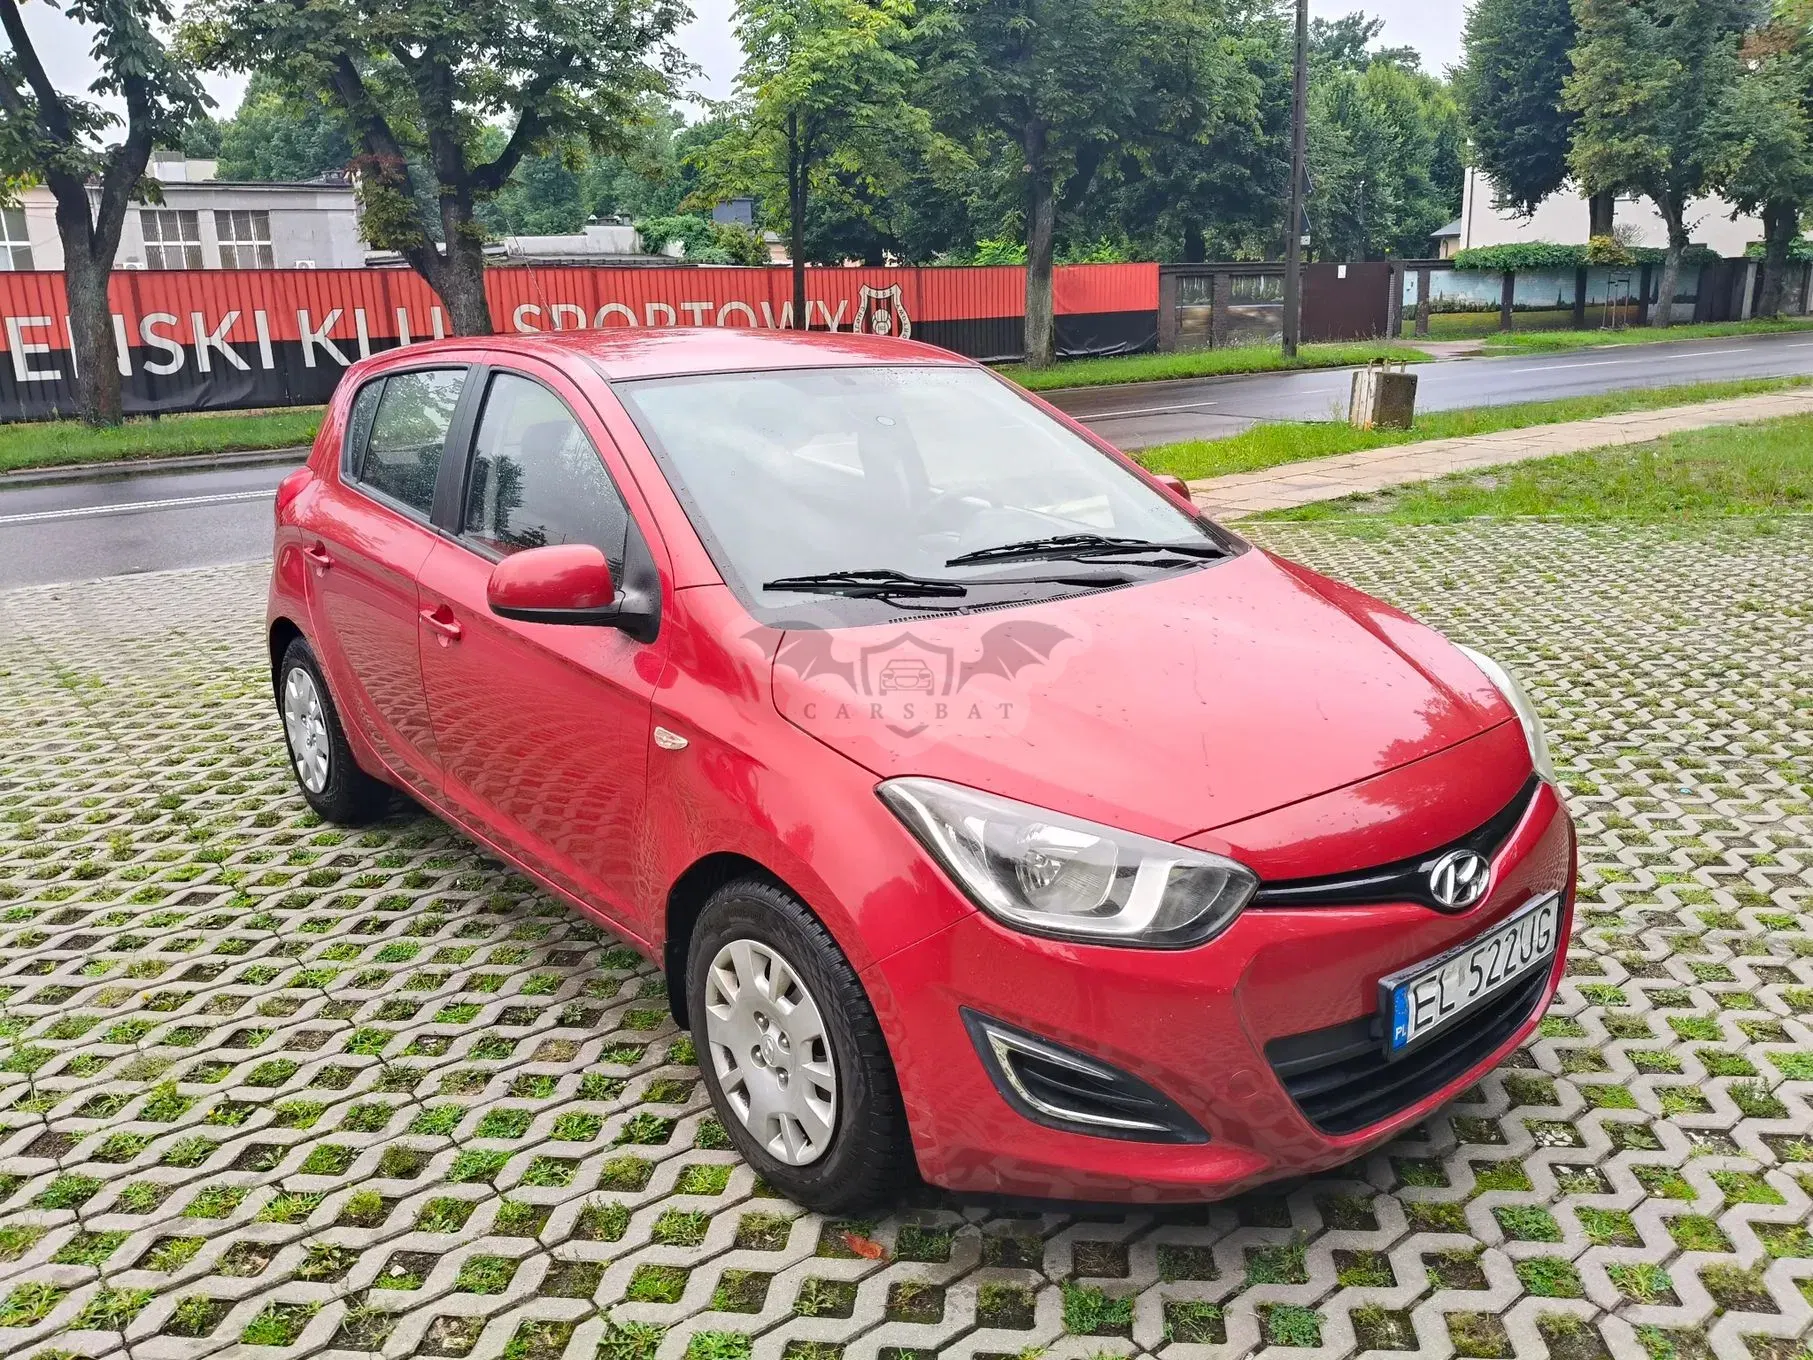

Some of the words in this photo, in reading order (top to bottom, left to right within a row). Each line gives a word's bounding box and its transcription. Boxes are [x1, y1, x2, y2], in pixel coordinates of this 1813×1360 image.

[1413, 967, 1455, 1032] EL
[1467, 907, 1551, 997] 522UG
[1395, 1024, 1407, 1040] PL
